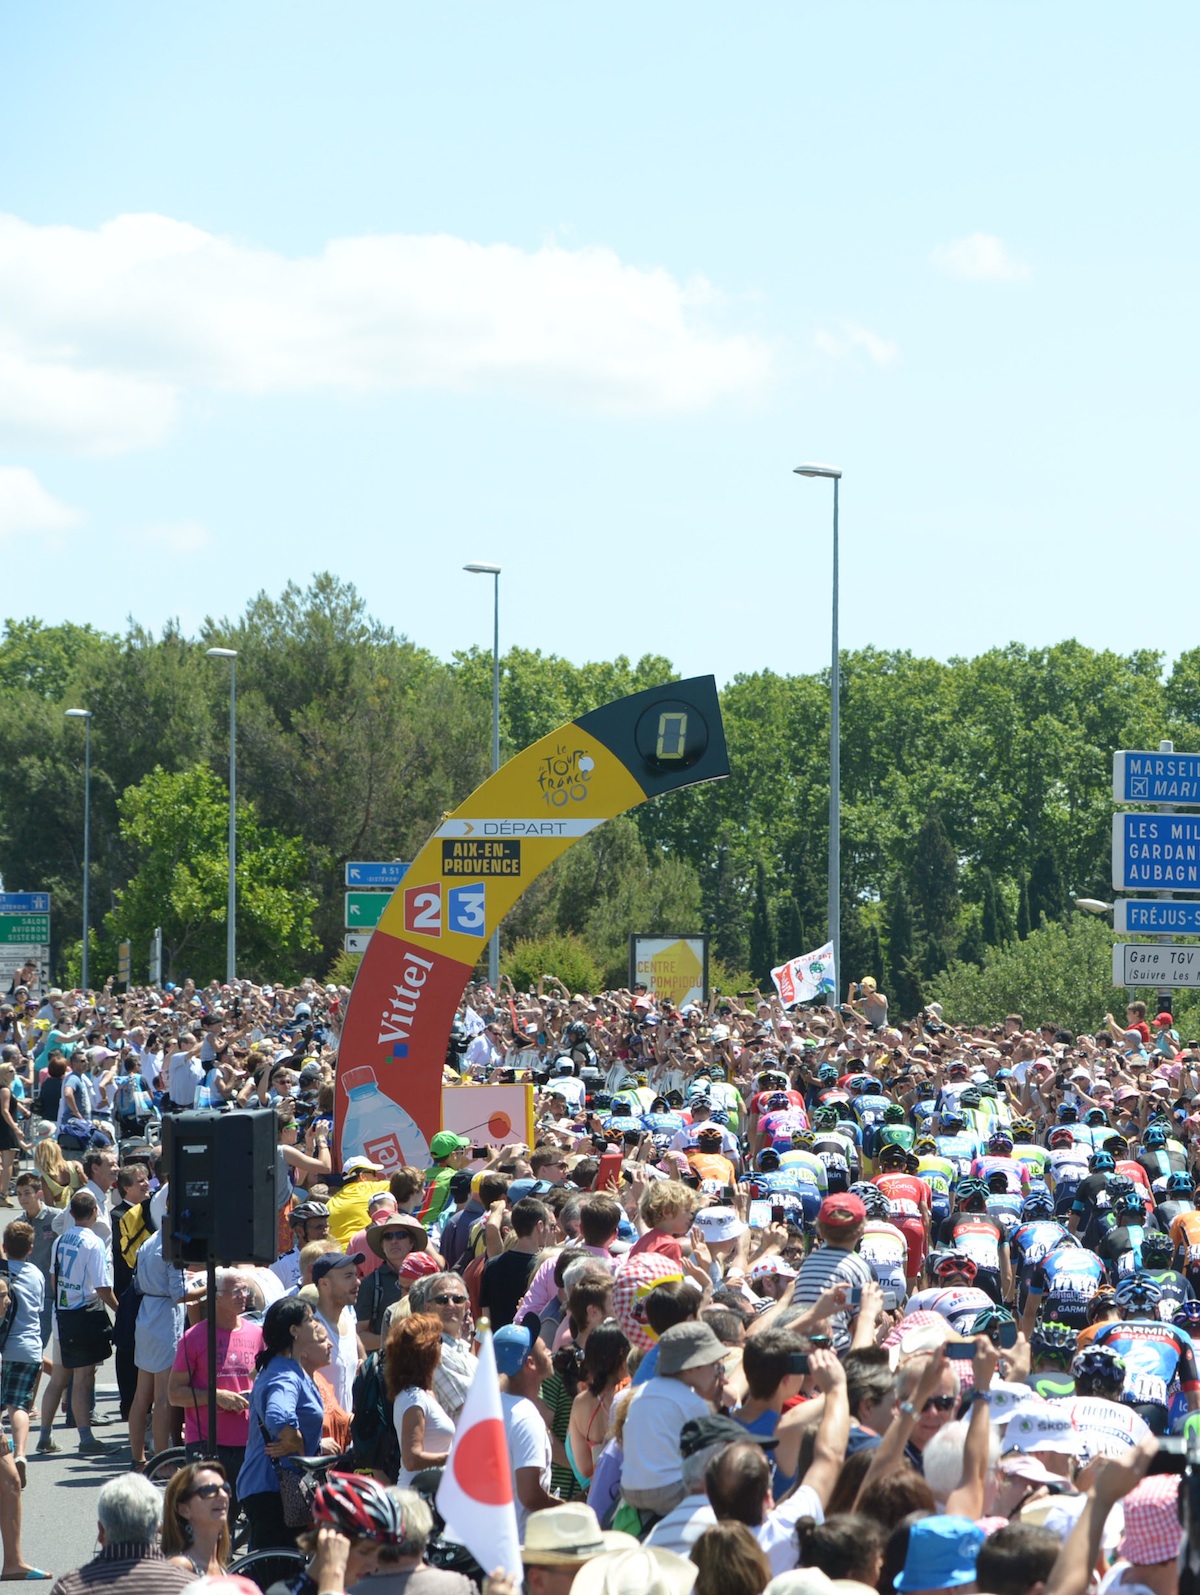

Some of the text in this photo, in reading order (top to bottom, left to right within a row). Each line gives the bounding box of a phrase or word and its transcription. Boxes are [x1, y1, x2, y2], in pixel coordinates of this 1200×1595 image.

[542, 784, 588, 808] 100
[484, 820, 567, 835] DÉPART
[1129, 823, 1158, 838] LES
[453, 843, 510, 856] AIX-EN-
[444, 858, 518, 873] PROVENCE
[413, 894, 441, 928] 2
[457, 892, 484, 928] 3
[1130, 951, 1194, 964] Gare TGV
[638, 961, 676, 973] CENTRE
[1129, 968, 1166, 981] (Suivre
[1173, 970, 1190, 981] Les
[650, 976, 703, 988] POMPIDOU
[378, 952, 434, 1044] Vittel
[1110, 1326, 1174, 1340] GARMIN
